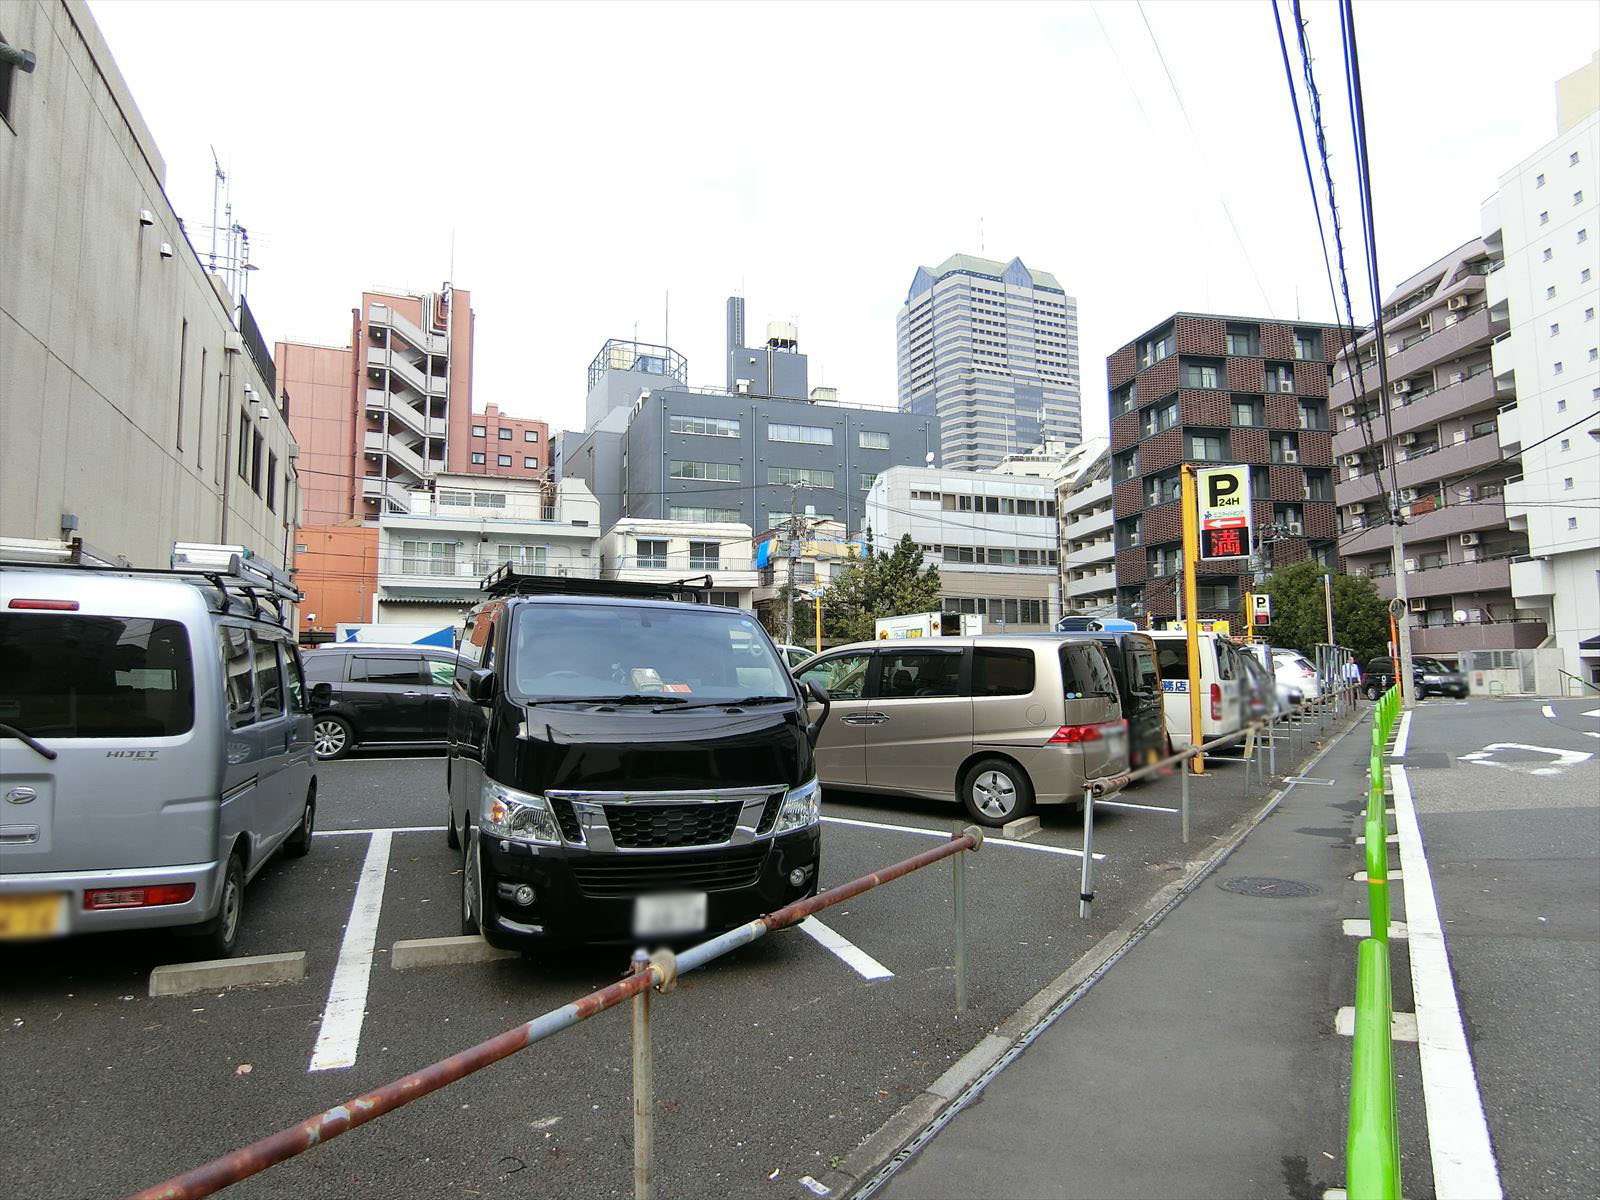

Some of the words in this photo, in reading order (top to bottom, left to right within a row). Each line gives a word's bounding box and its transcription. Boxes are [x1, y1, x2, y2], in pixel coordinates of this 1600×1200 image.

[1208, 474, 1239, 507] P
[1219, 497, 1240, 506] 24H
[1211, 530, 1239, 556] 満
[1256, 597, 1266, 608] P
[1161, 680, 1187, 692] 務店
[106, 750, 159, 758] HIJET
